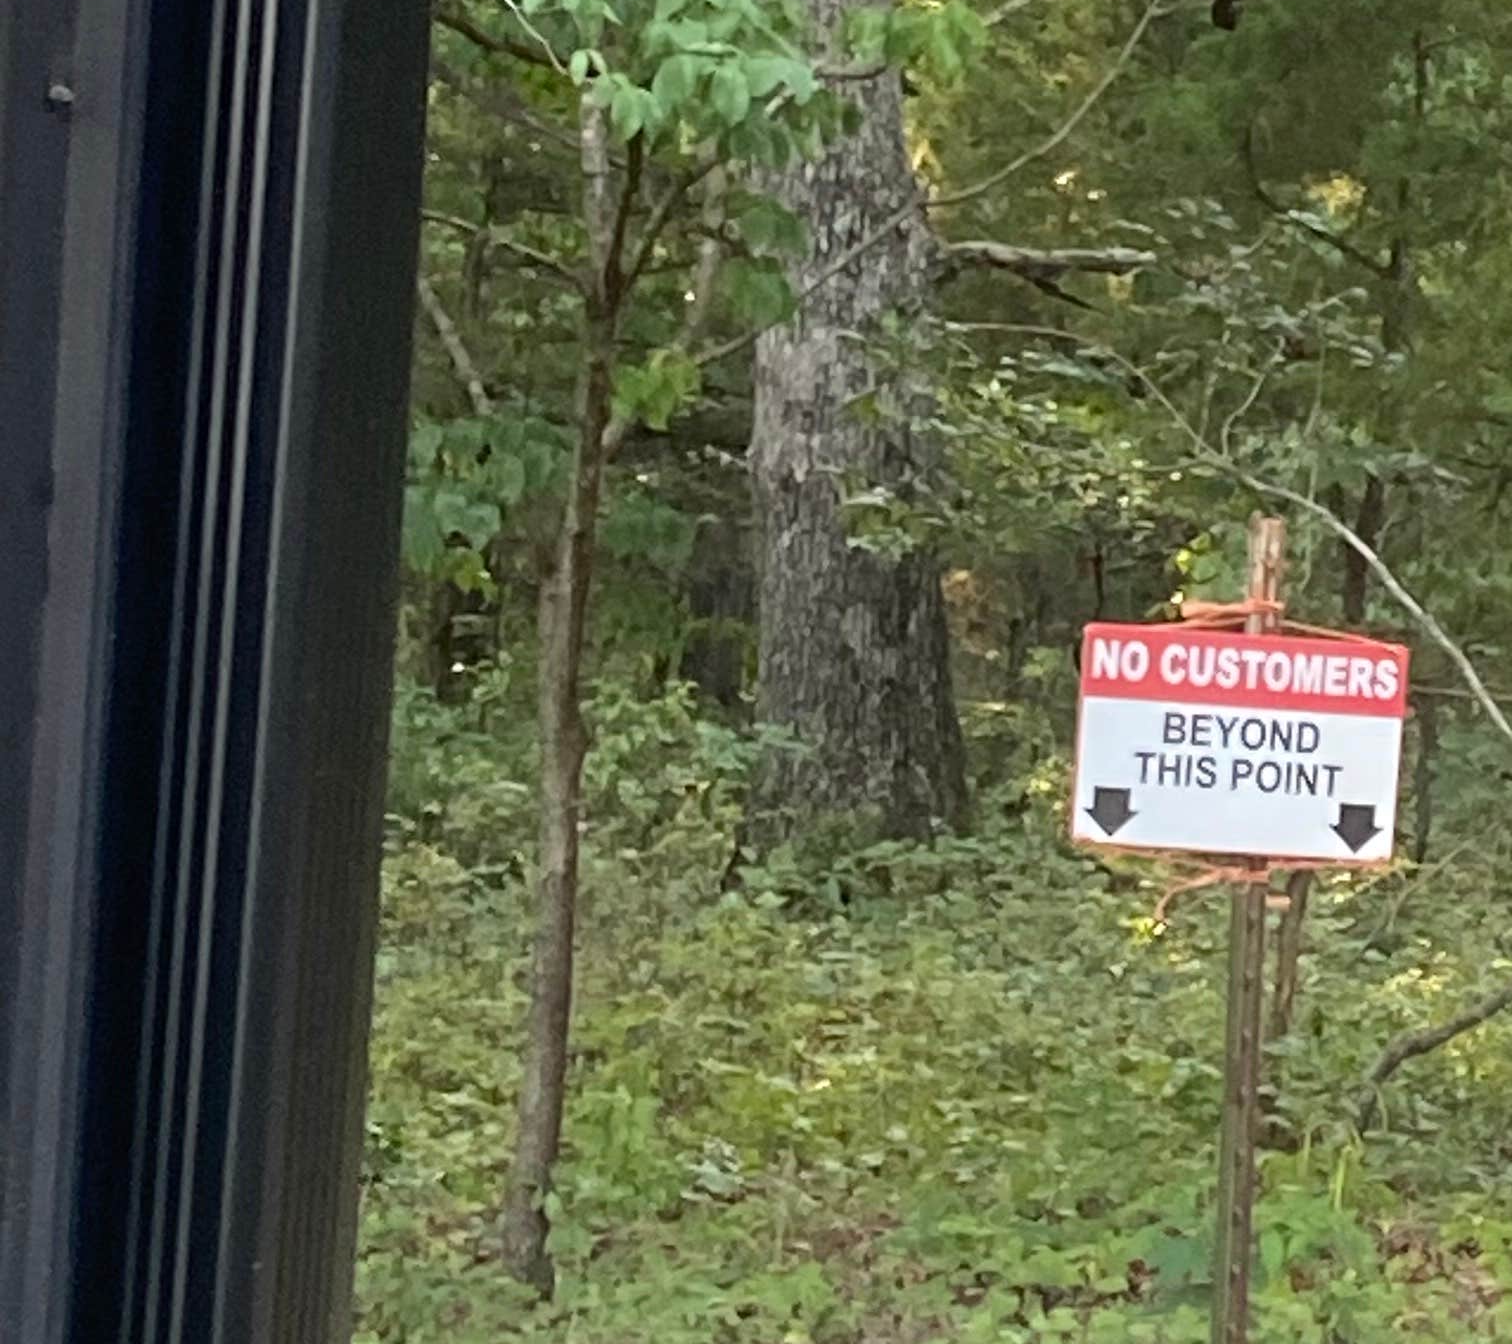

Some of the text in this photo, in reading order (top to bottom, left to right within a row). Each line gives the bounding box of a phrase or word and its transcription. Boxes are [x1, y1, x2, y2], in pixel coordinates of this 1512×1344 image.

[1092, 639, 1399, 699] NO CUSTOMERS
[1163, 712, 1321, 754] BEYOND
[1135, 752, 1343, 797] THIS POINT
